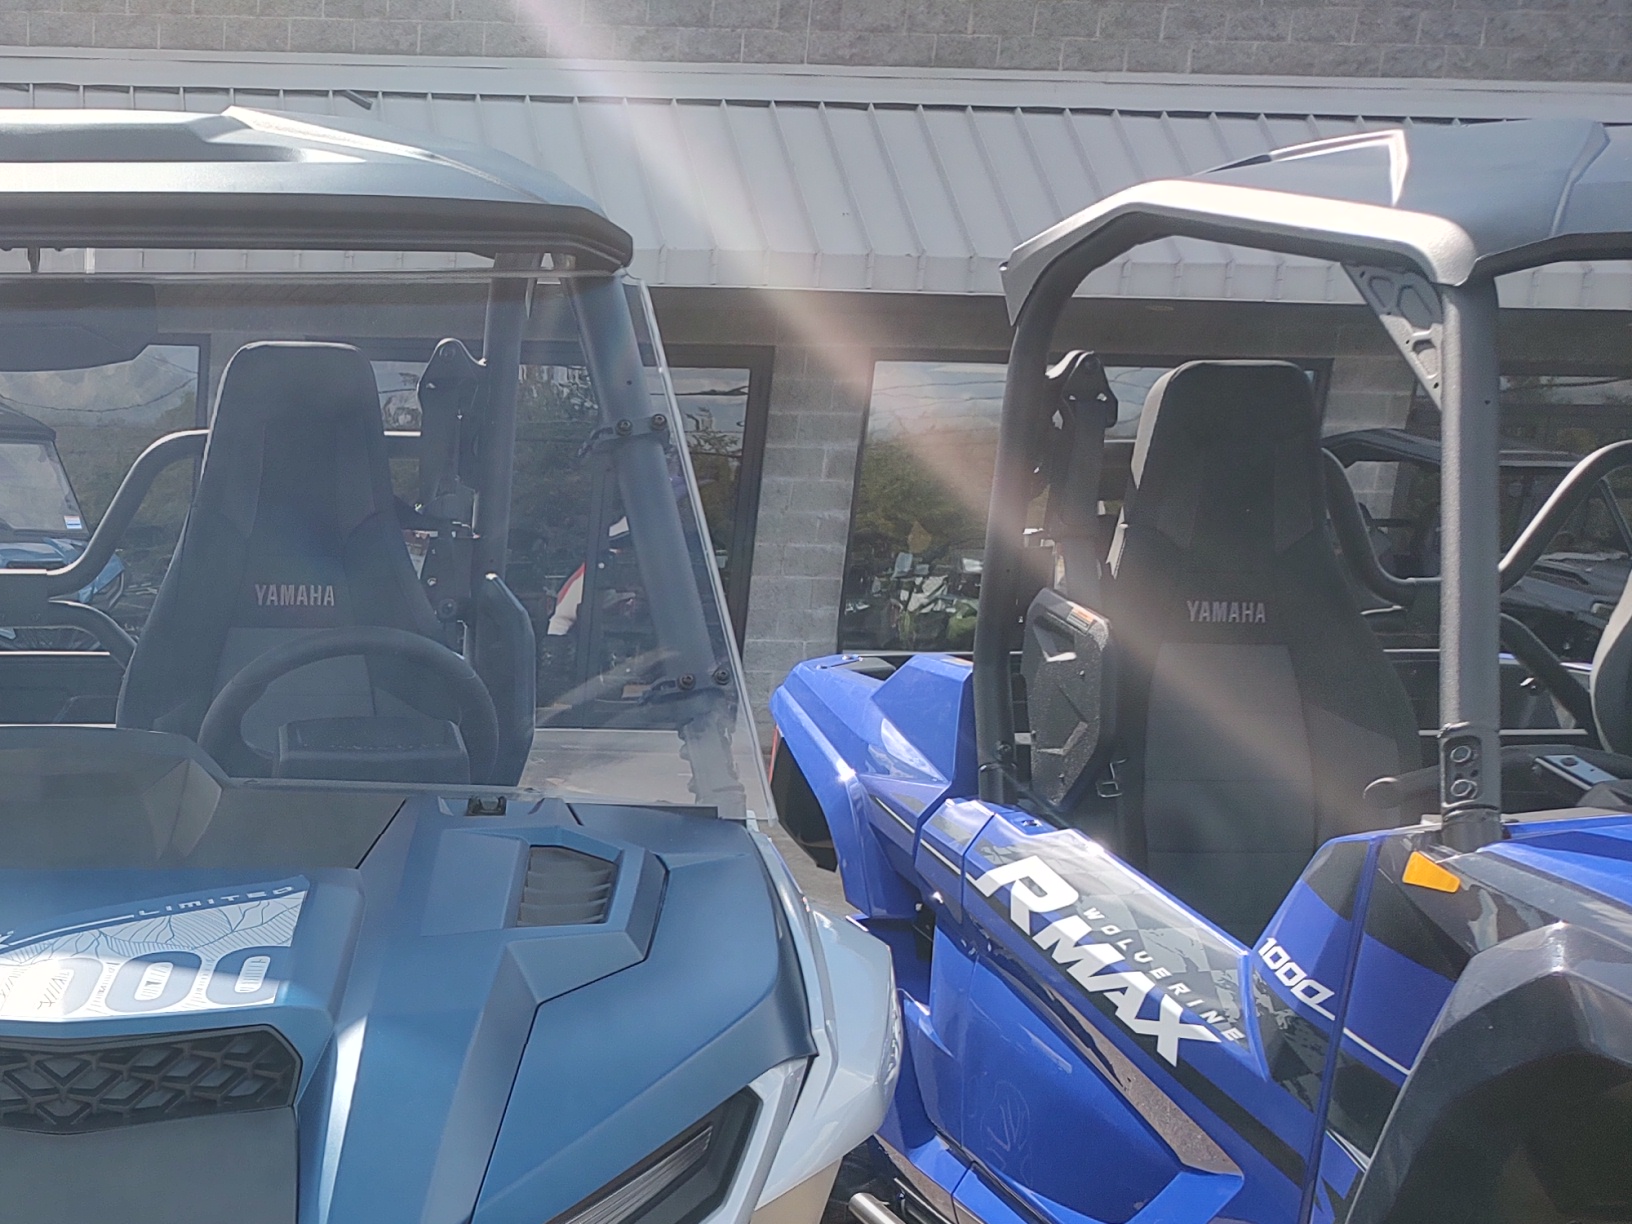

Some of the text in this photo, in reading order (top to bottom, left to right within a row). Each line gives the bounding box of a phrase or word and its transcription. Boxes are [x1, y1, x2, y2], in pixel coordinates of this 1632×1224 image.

[253, 584, 335, 606] YAMAHA
[1186, 600, 1266, 623] YAMAHA
[138, 886, 294, 917] LIMITED
[965, 855, 1222, 1067] RMAX
[1082, 907, 1246, 1042] WOLVERINE
[1257, 937, 1337, 1021] 1000
